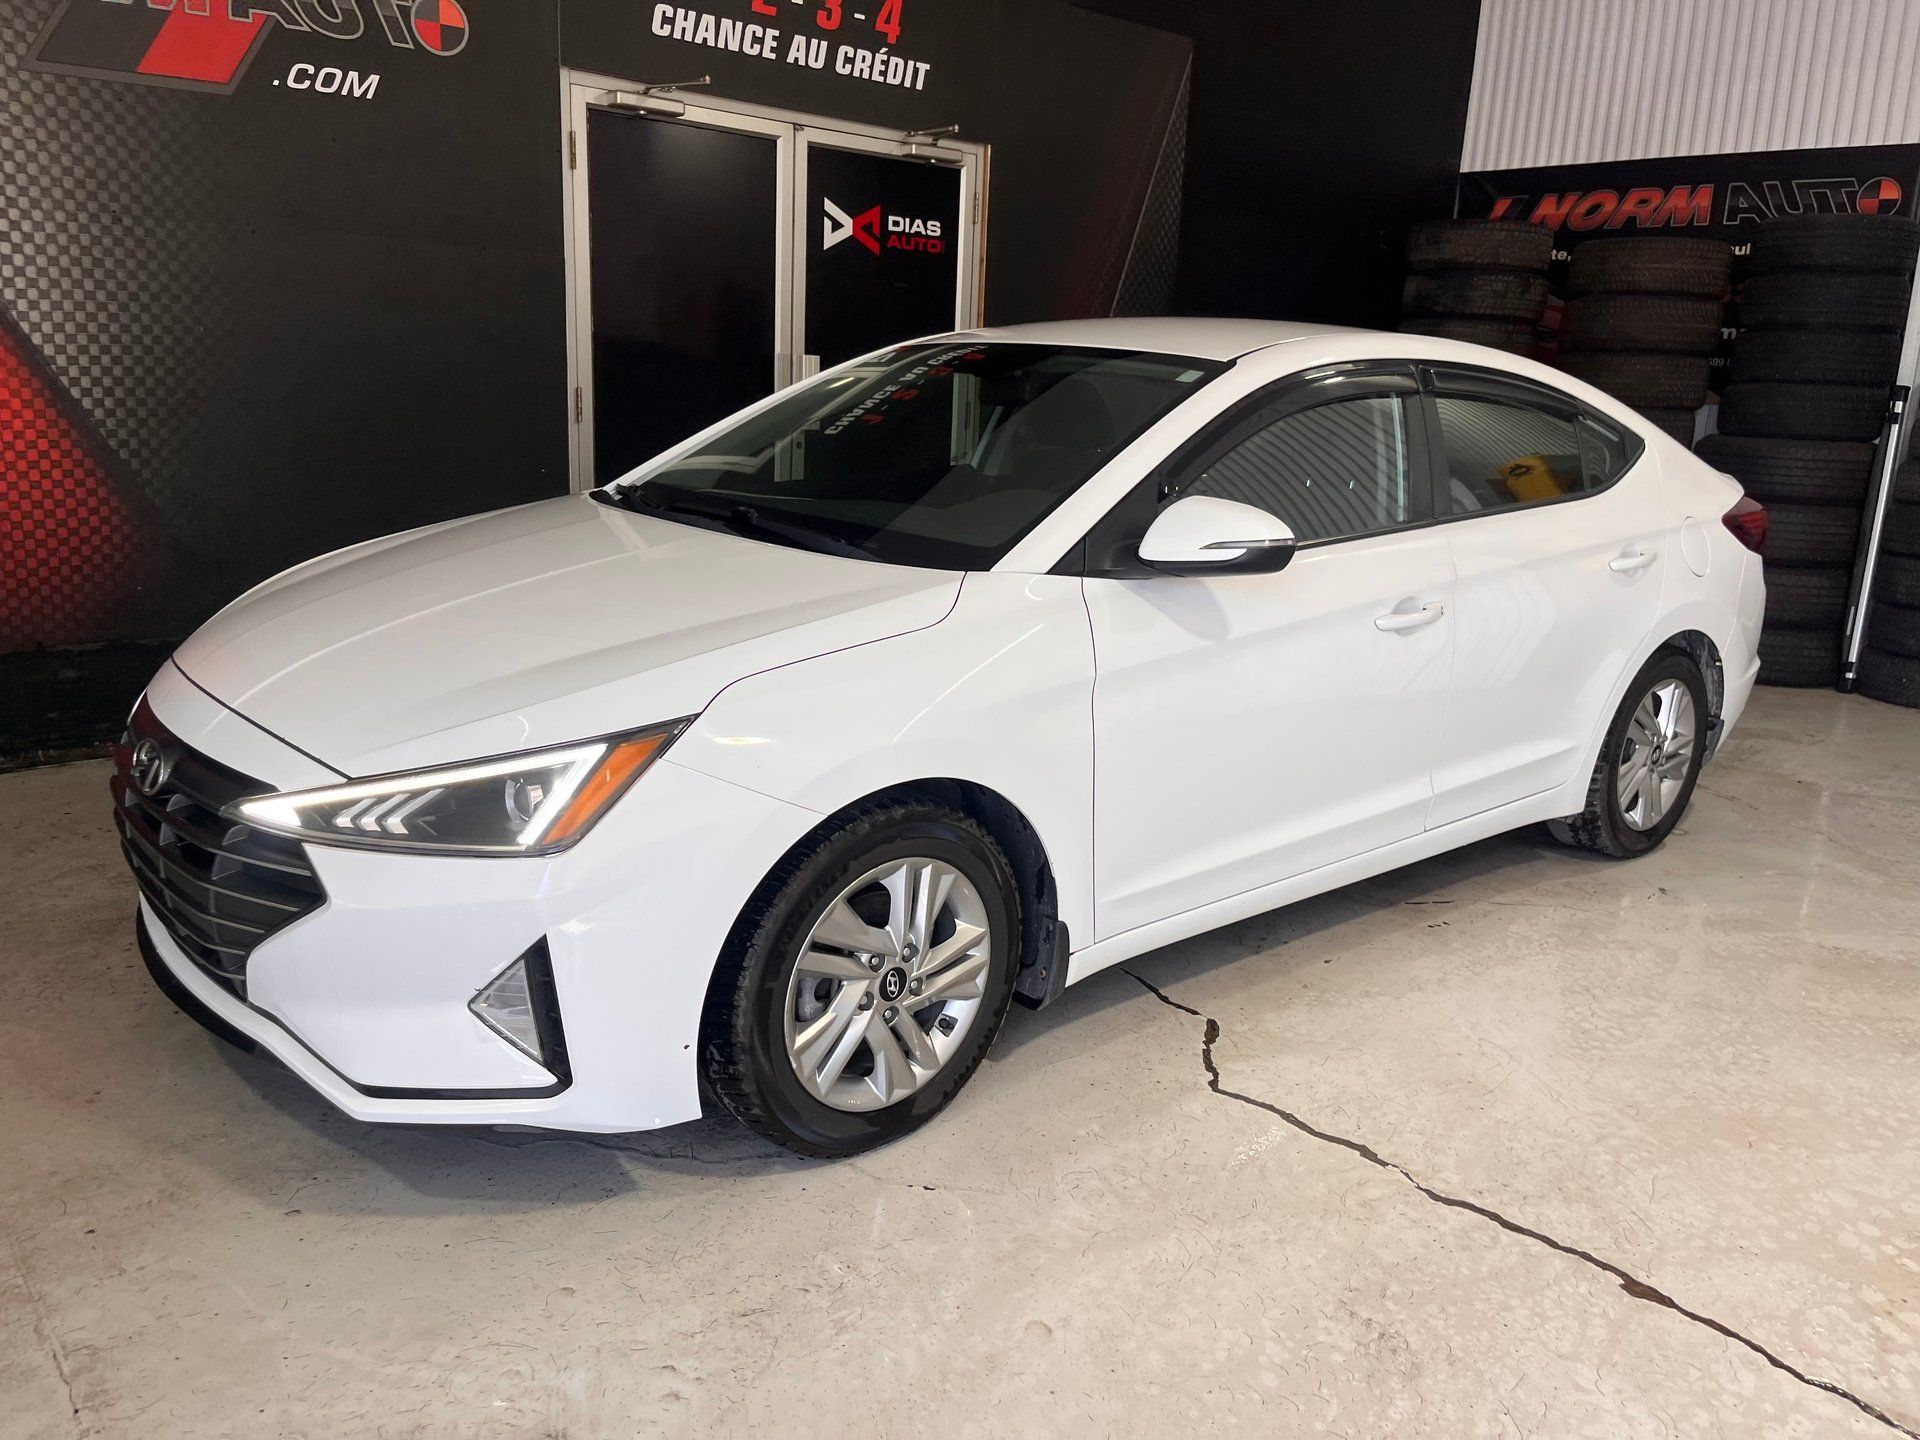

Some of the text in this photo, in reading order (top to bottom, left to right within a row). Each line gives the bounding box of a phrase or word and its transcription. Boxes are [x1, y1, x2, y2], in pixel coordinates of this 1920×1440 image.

[651, 3, 931, 91] CHANCE AU CRÉDIT
[272, 62, 380, 99] .COM
[1528, 176, 1902, 232] NORM AUTO
[887, 234, 943, 253] AUTO
[888, 215, 941, 237] DIAS
